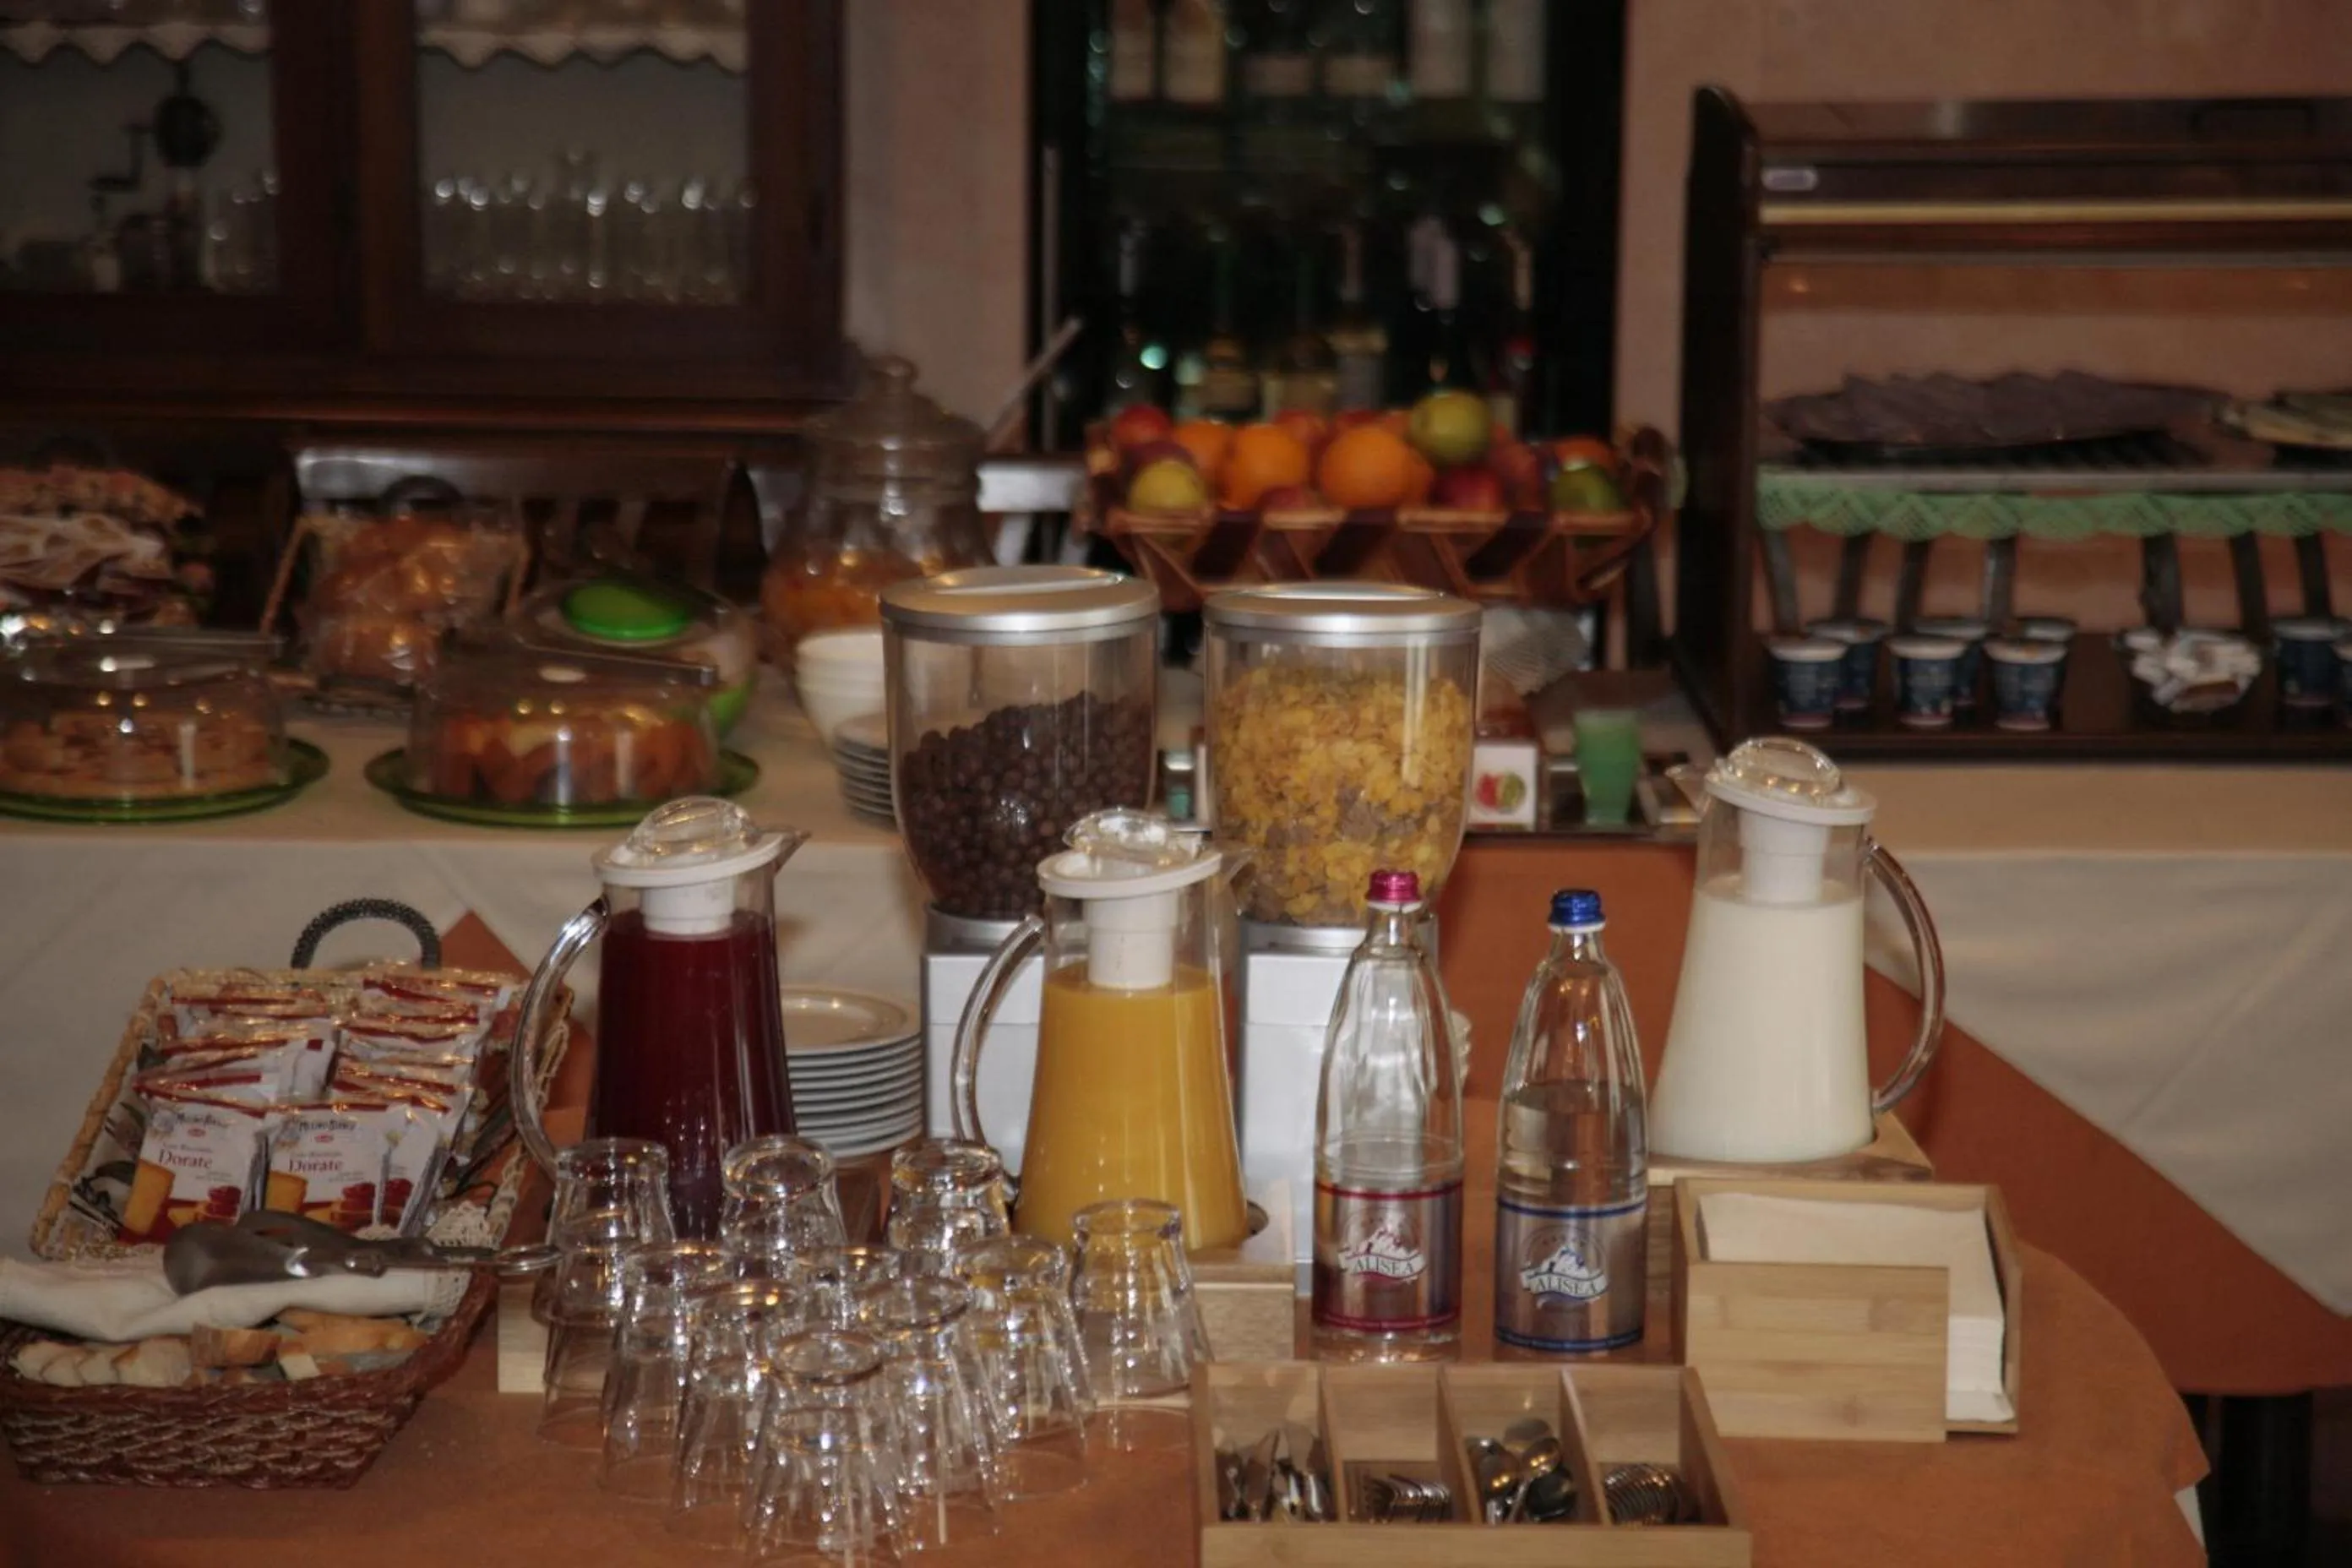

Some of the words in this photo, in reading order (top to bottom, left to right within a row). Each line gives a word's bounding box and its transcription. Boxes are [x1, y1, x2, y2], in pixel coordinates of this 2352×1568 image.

[158, 1149, 213, 1168] Dorate
[289, 1158, 344, 1173] Dorate
[1353, 1257, 1414, 1275] ALISEA
